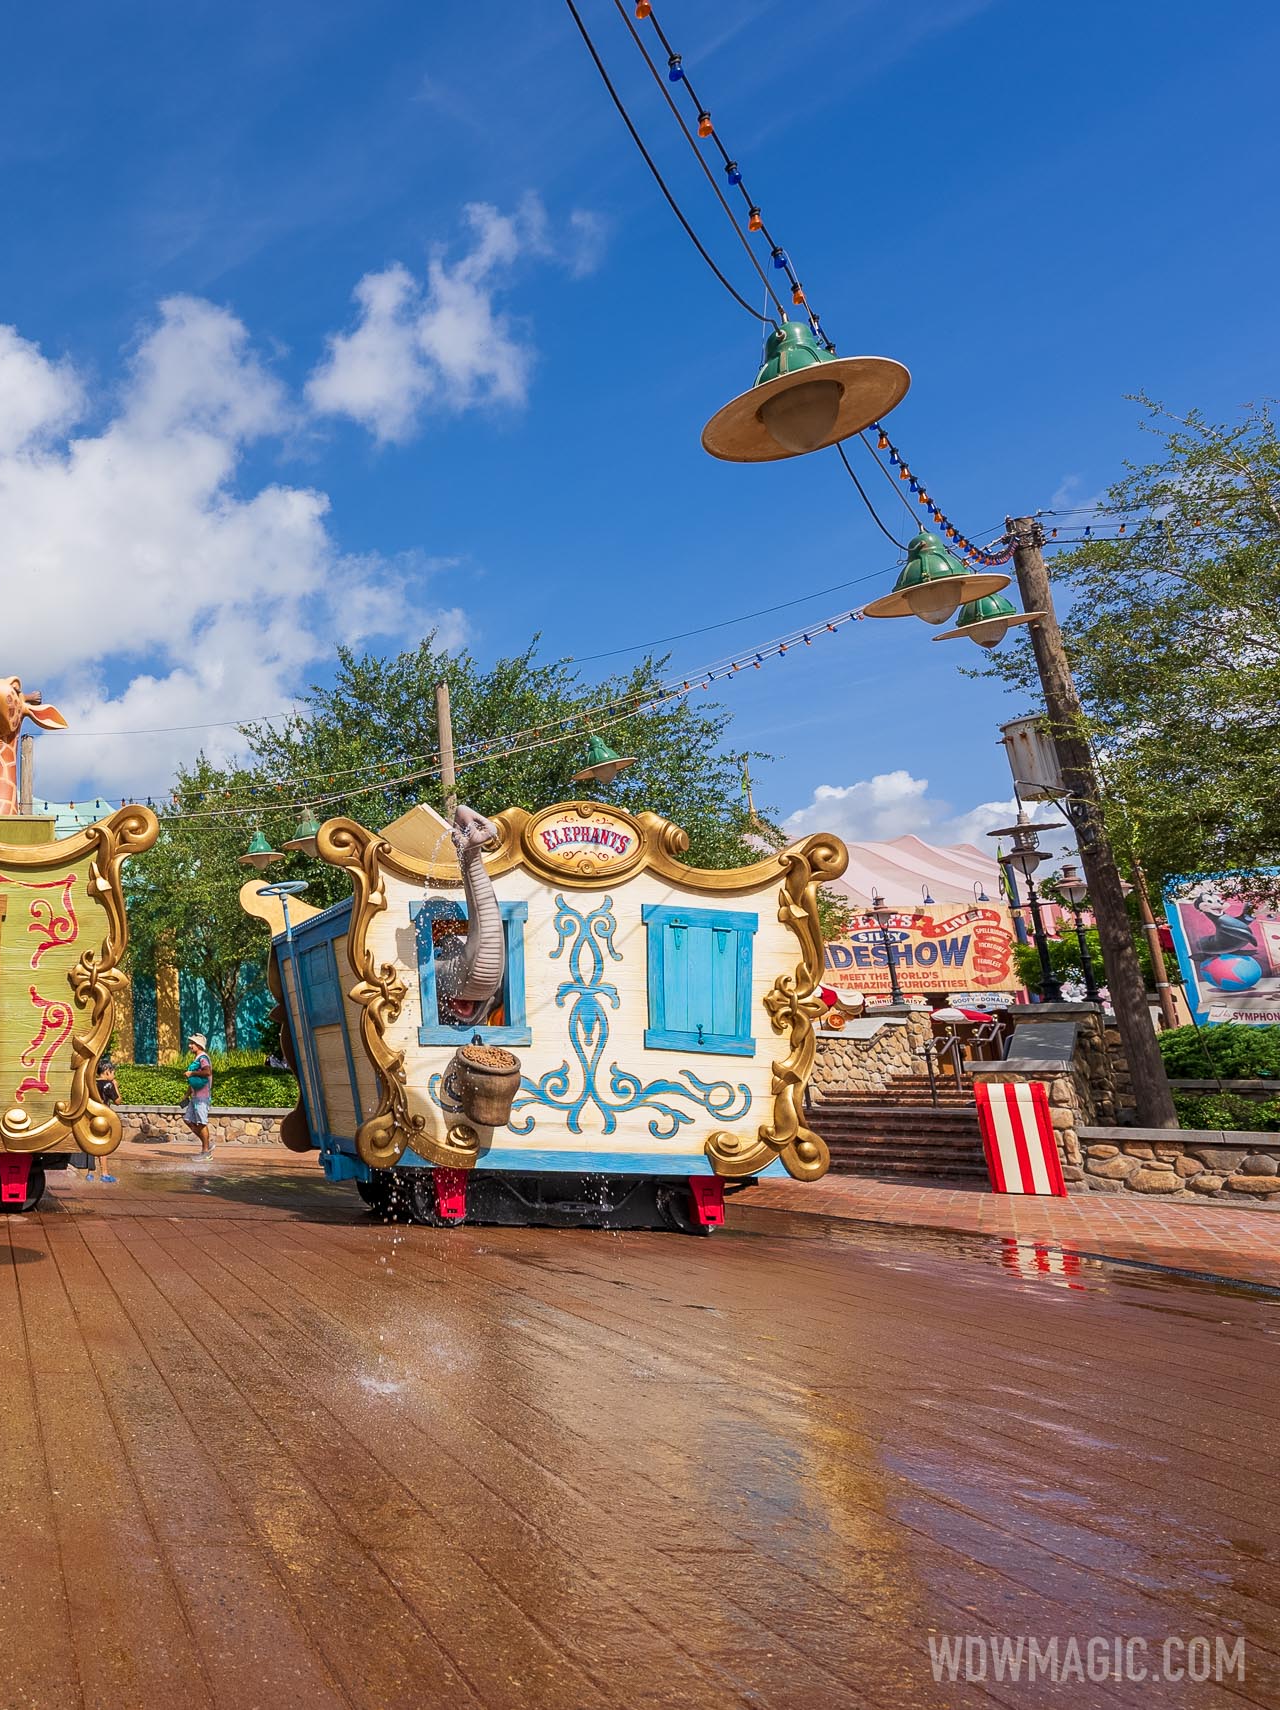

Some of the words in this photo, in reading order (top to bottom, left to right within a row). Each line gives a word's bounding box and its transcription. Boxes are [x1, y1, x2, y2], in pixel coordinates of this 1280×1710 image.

[540, 826, 633, 855] ELEPHANTS
[942, 909, 984, 933] LIVE!
[858, 932, 902, 942] SILLY
[823, 934, 972, 969] IDESHOW
[840, 973, 866, 981] MEET
[898, 980, 968, 989] CURIOSITIES!
[1233, 1012, 1280, 1021] SYMPHON
